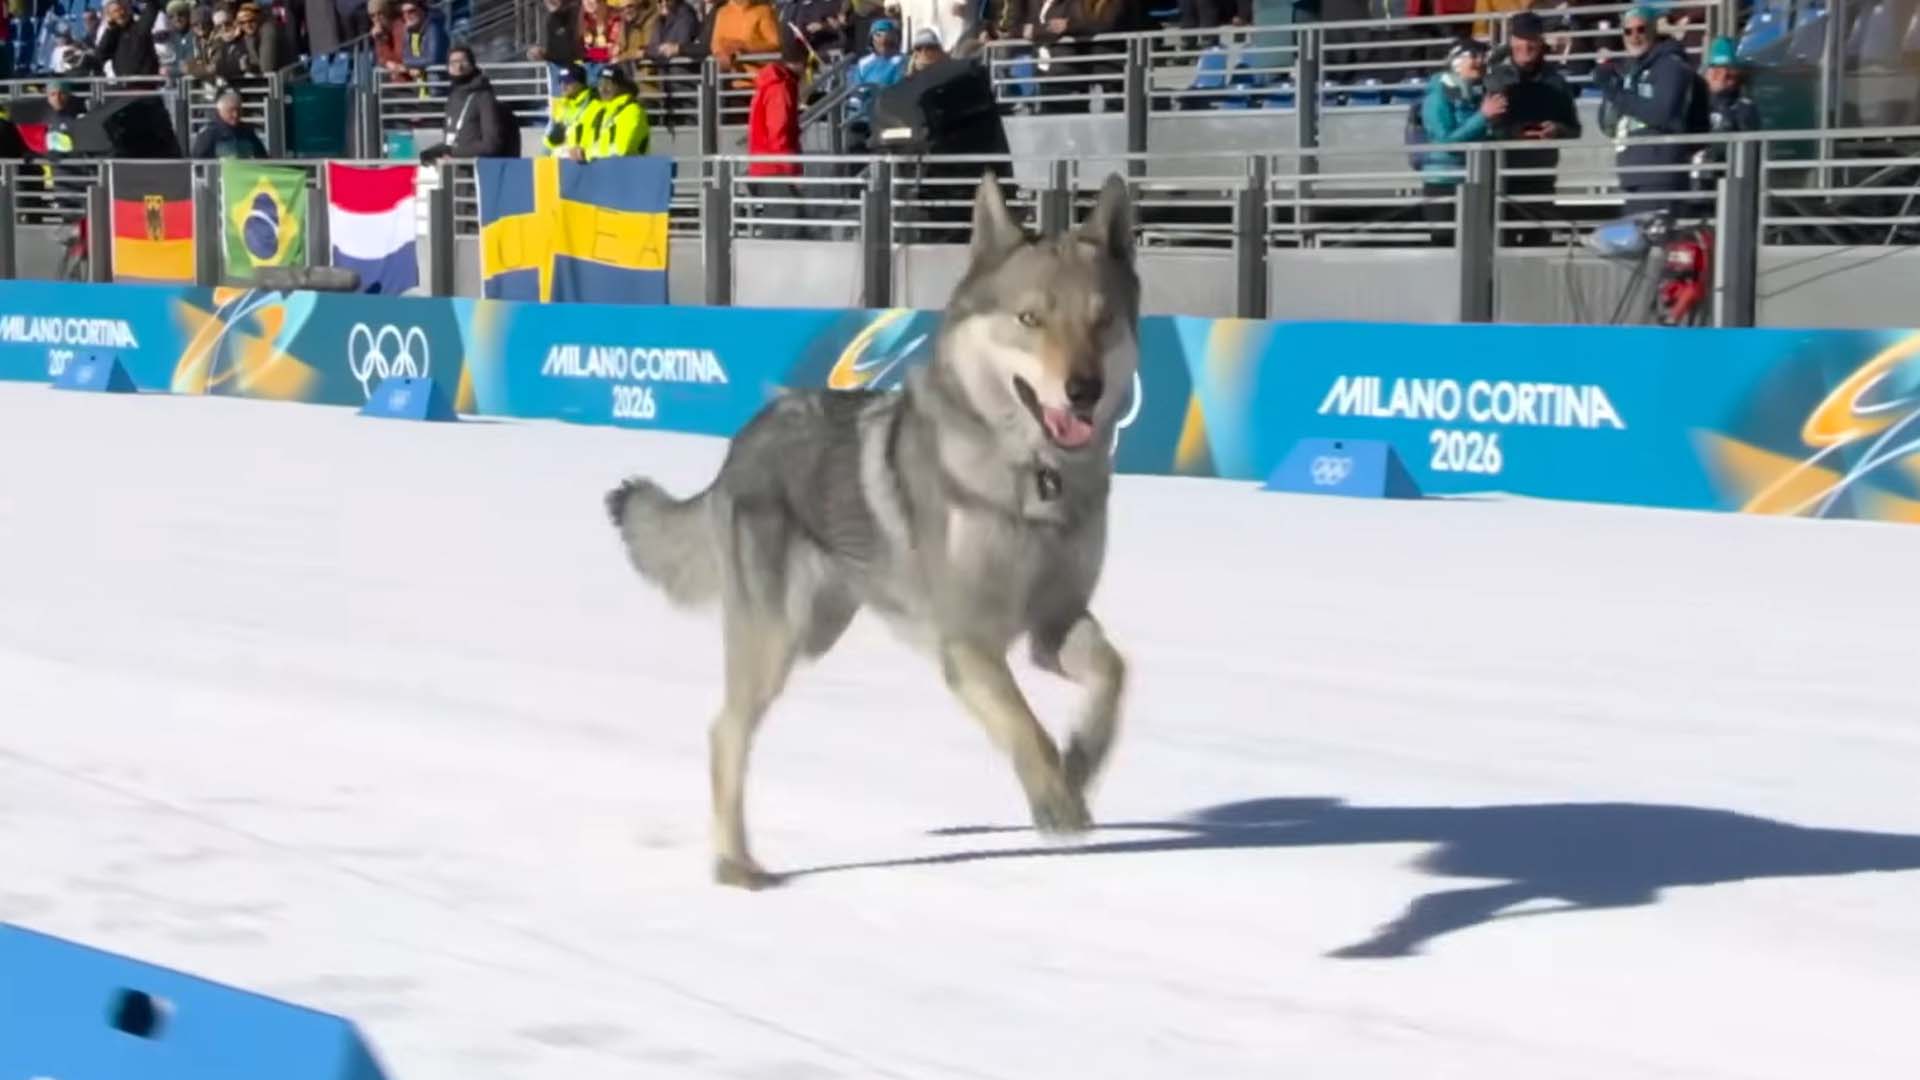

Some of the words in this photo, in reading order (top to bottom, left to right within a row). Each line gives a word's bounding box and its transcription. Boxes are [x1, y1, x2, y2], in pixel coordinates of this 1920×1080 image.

[0, 315, 62, 344] MILANO
[65, 317, 139, 349] CORTINA
[541, 345, 627, 379] MILANO
[630, 347, 728, 384] CORTINA
[612, 384, 656, 420] 2026
[1317, 375, 1462, 421] MILANO
[1466, 382, 1627, 430] CORTINA
[1429, 428, 1503, 475] 2026
